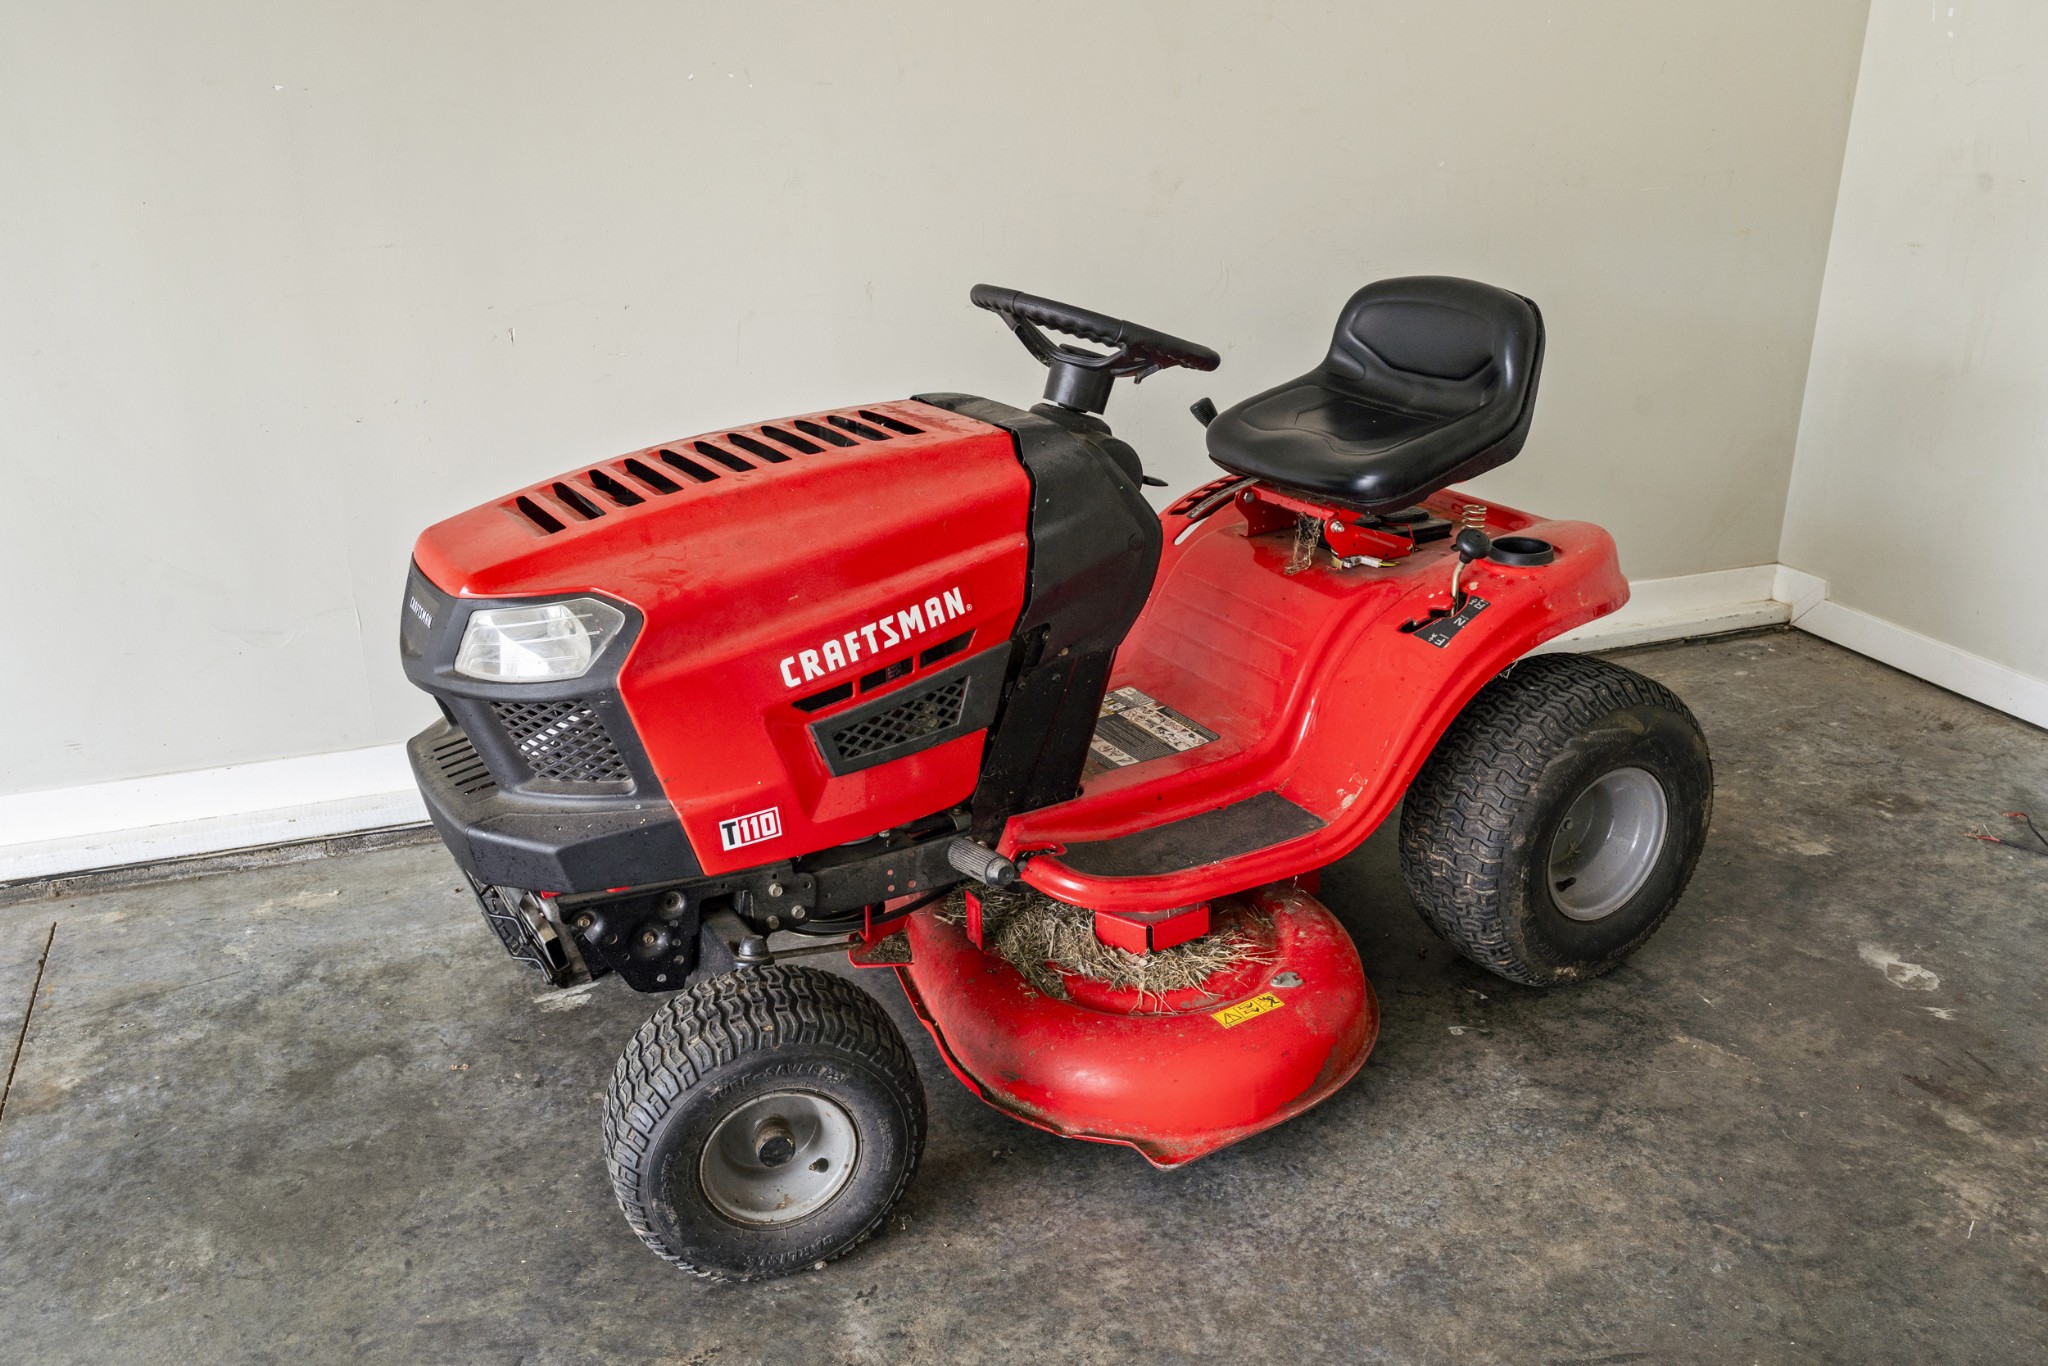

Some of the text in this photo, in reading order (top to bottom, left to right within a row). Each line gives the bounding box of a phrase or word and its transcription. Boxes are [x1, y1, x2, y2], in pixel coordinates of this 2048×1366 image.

[409, 596, 433, 629] CRAFTSMAN
[780, 587, 966, 688] CRAFTSMAN
[721, 811, 777, 846] T110
